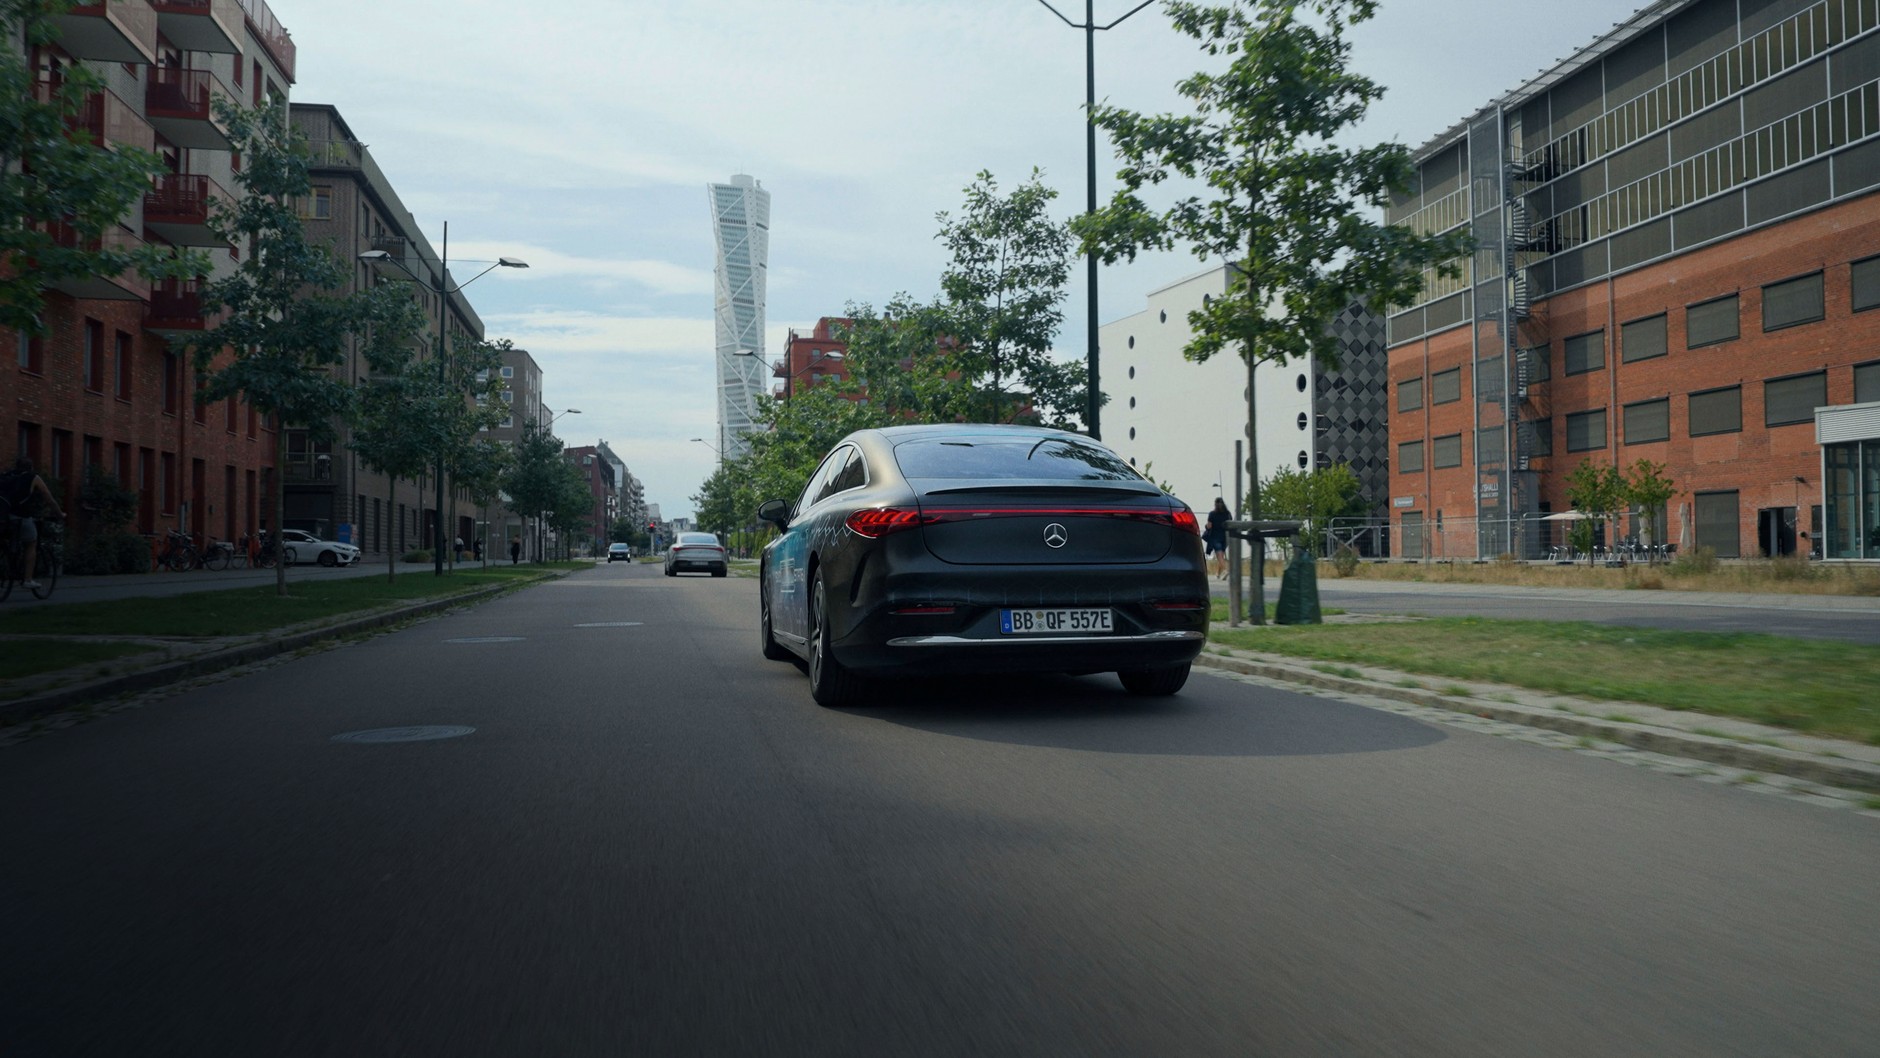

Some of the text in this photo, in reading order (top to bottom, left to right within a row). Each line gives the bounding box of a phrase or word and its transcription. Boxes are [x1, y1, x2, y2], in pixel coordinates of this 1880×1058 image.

[1012, 610, 1111, 630] BB QF 557E
